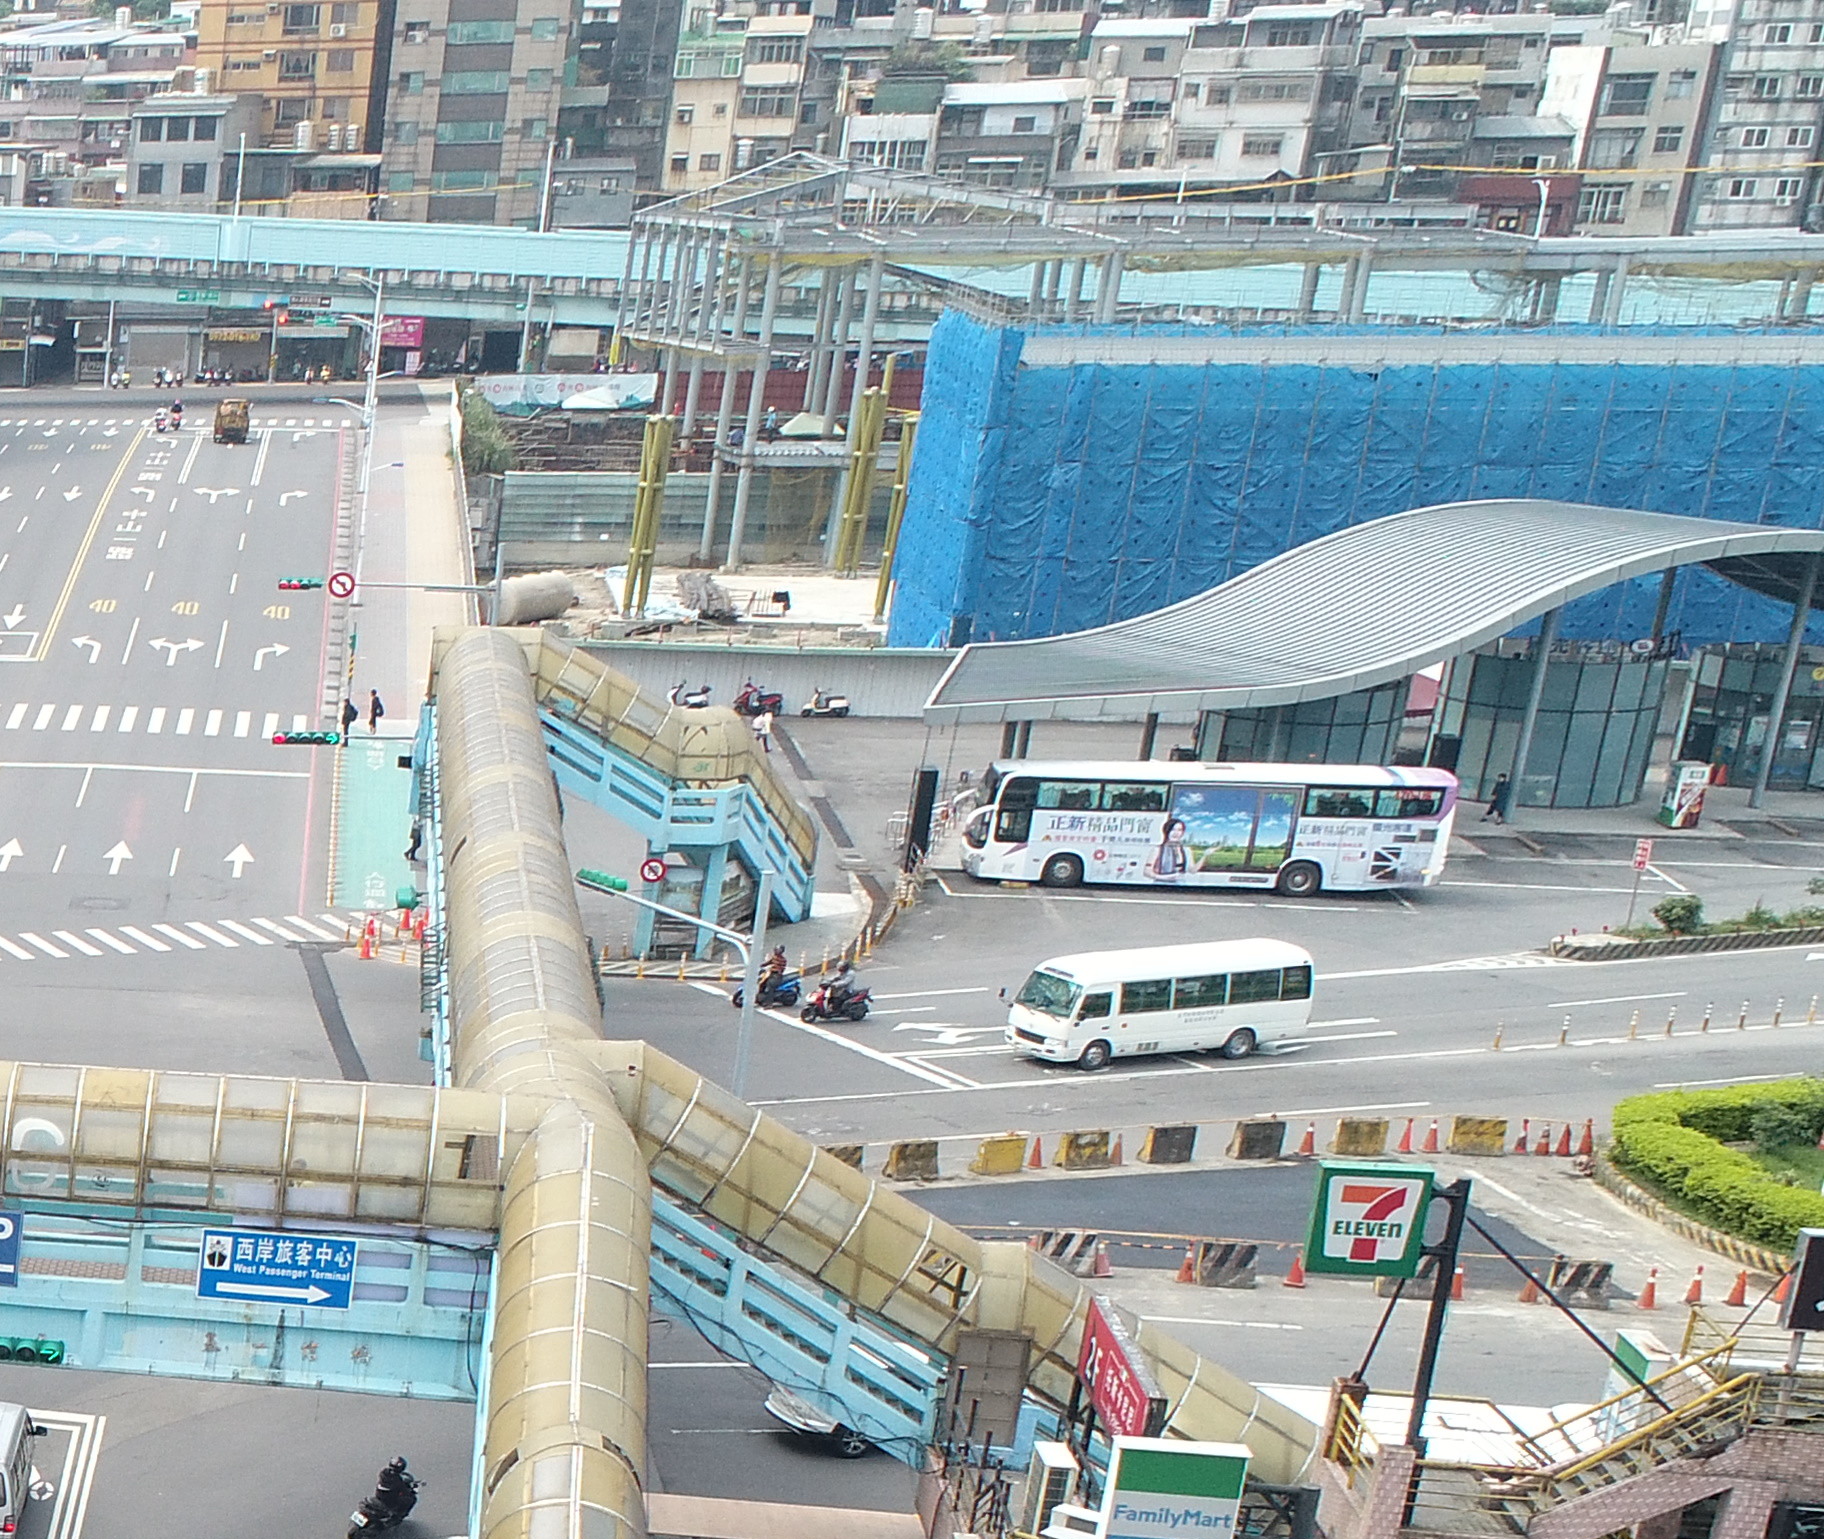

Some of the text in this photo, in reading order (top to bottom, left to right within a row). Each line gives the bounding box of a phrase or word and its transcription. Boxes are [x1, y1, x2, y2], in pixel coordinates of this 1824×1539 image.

[89, 599, 116, 612] 40
[172, 601, 199, 615] 40
[263, 605, 290, 619] 40
[1341, 1184, 1407, 1260] 7
[236, 1238, 352, 1268] 西岸旅客中心
[233, 1263, 350, 1282] West Passenger Terminal
[1113, 1504, 1232, 1529] FamilyMart
